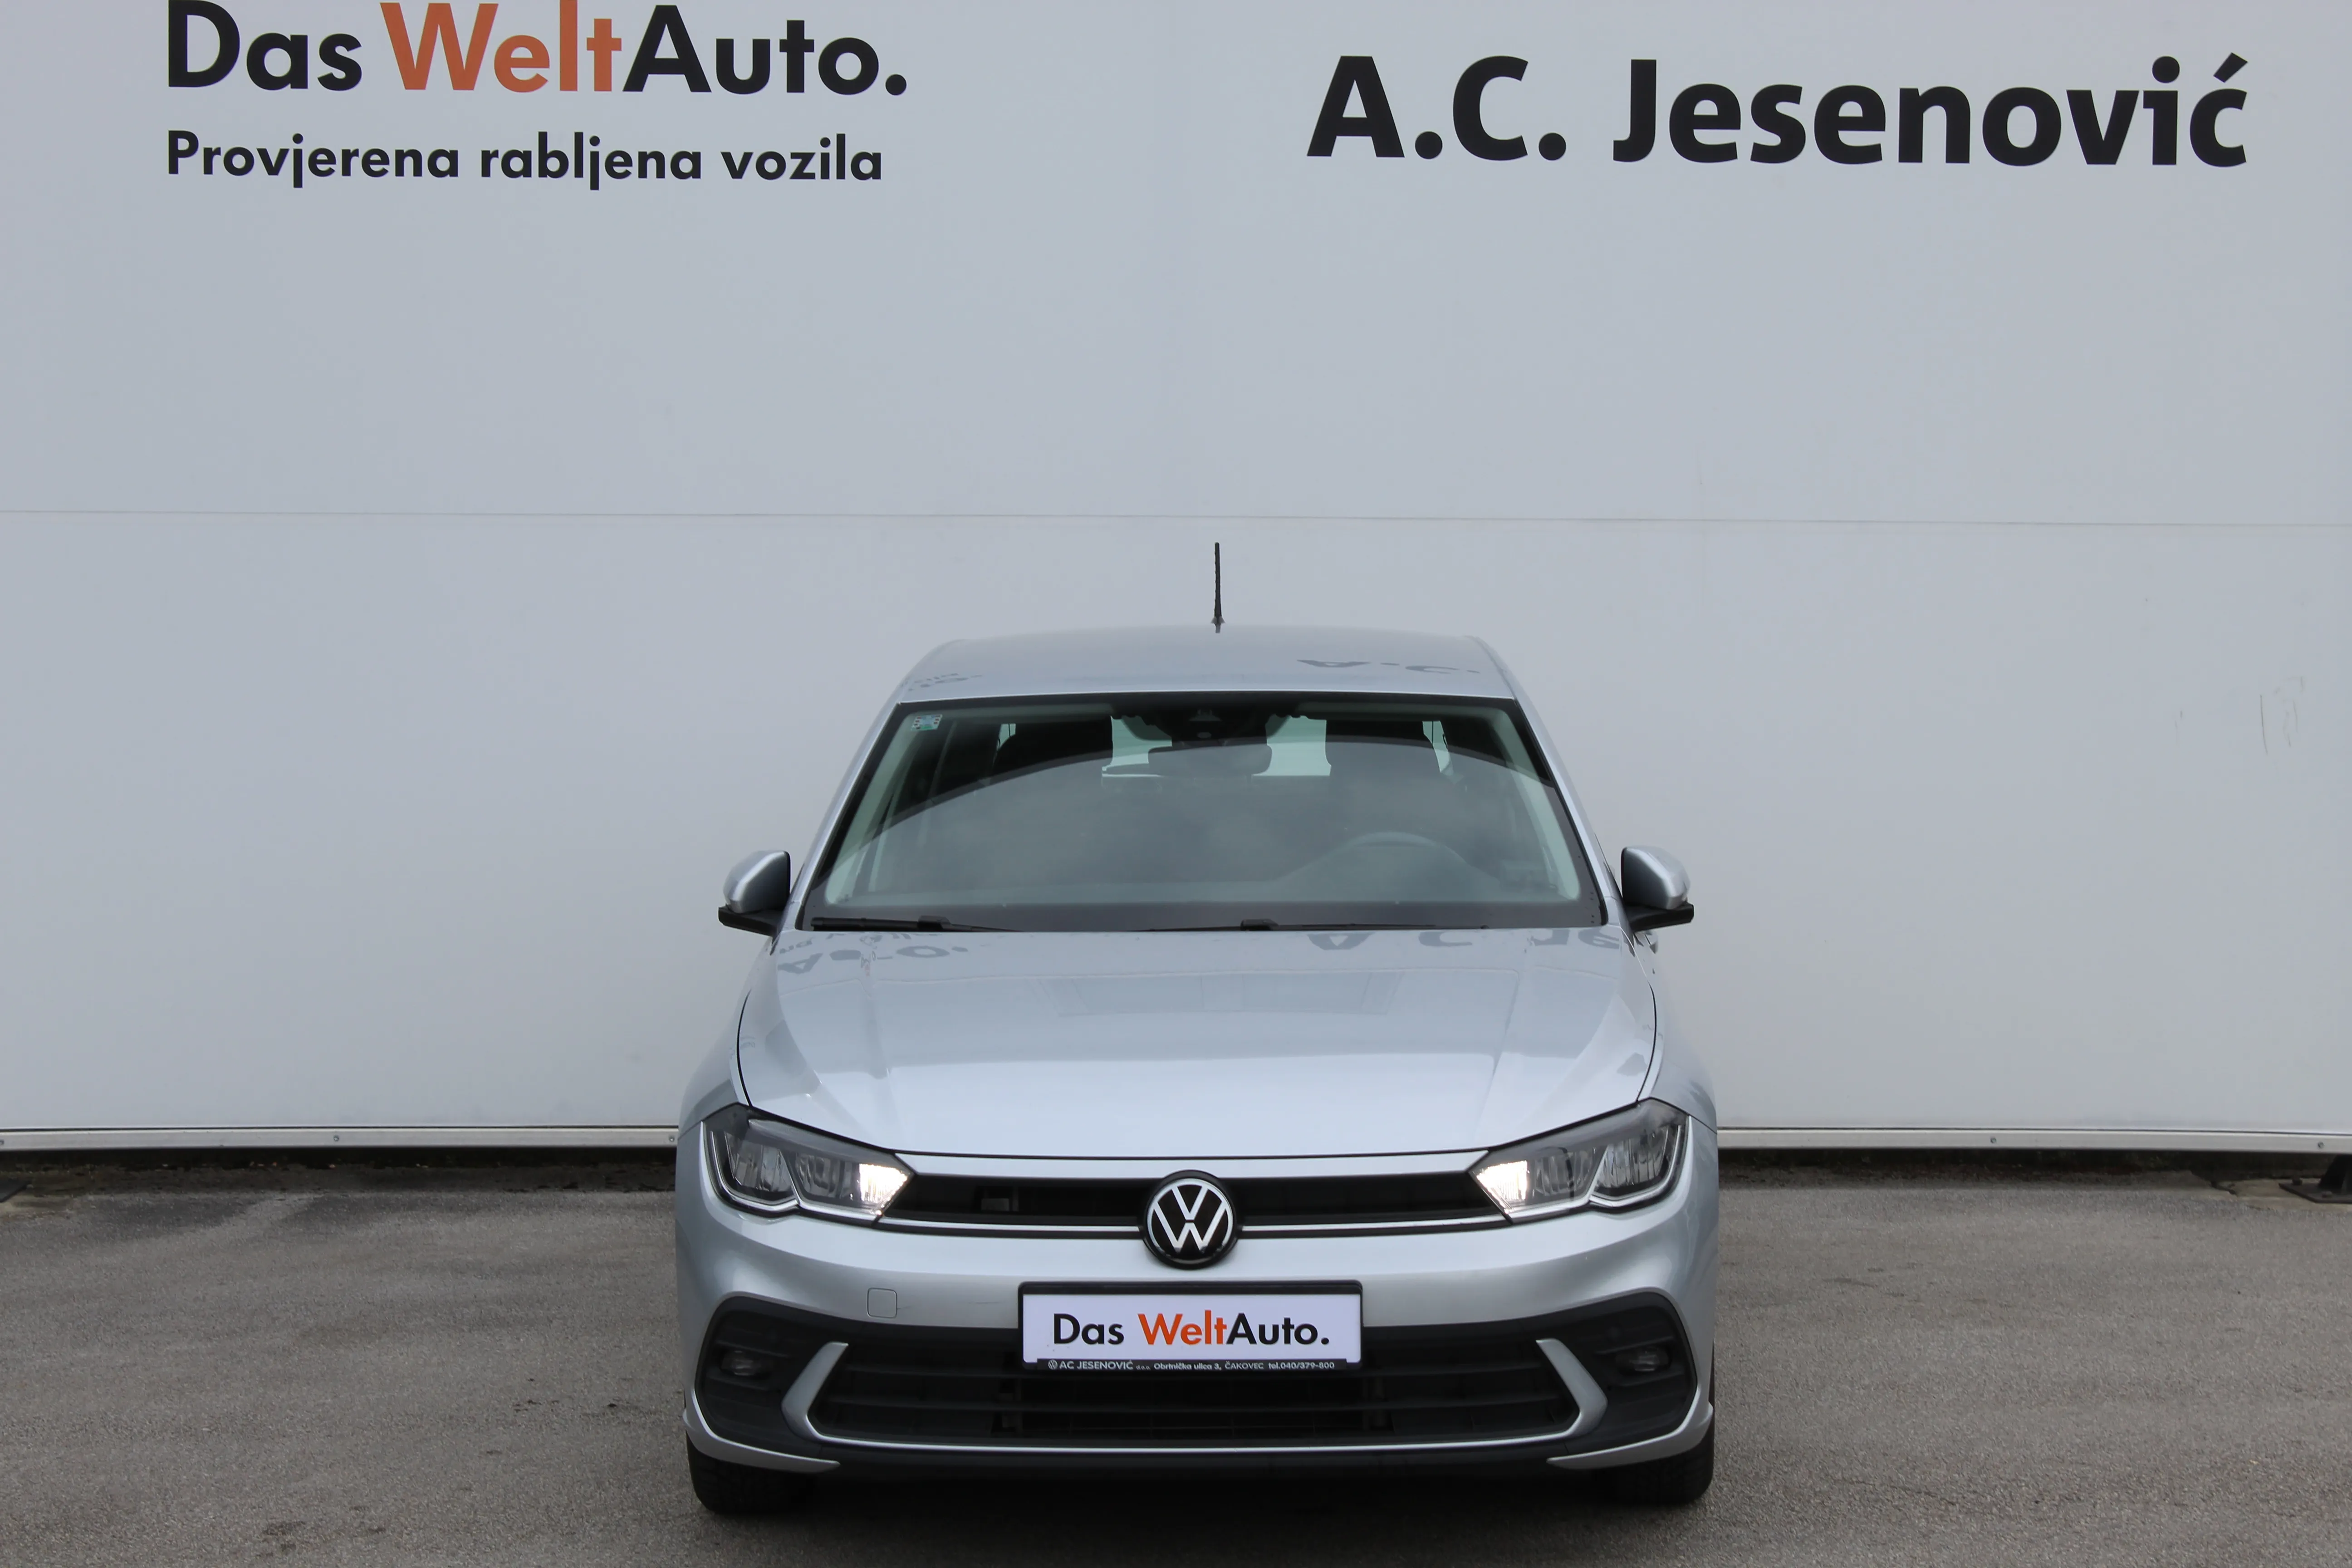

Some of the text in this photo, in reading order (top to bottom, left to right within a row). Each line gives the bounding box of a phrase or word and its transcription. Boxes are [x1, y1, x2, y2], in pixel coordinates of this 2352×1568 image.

[168, 0, 906, 95] Das WeltAuto.
[1307, 53, 2248, 167] A.C. Jesenović
[169, 131, 881, 190] Provjerena rabljena vozila
[1054, 1310, 1329, 1345] Das WeltAuto.
[1059, 1361, 1074, 1370] AC
[1077, 1360, 1133, 1370] JESENOVIĆ
[1225, 1361, 1264, 1369] ČAKOVEC
